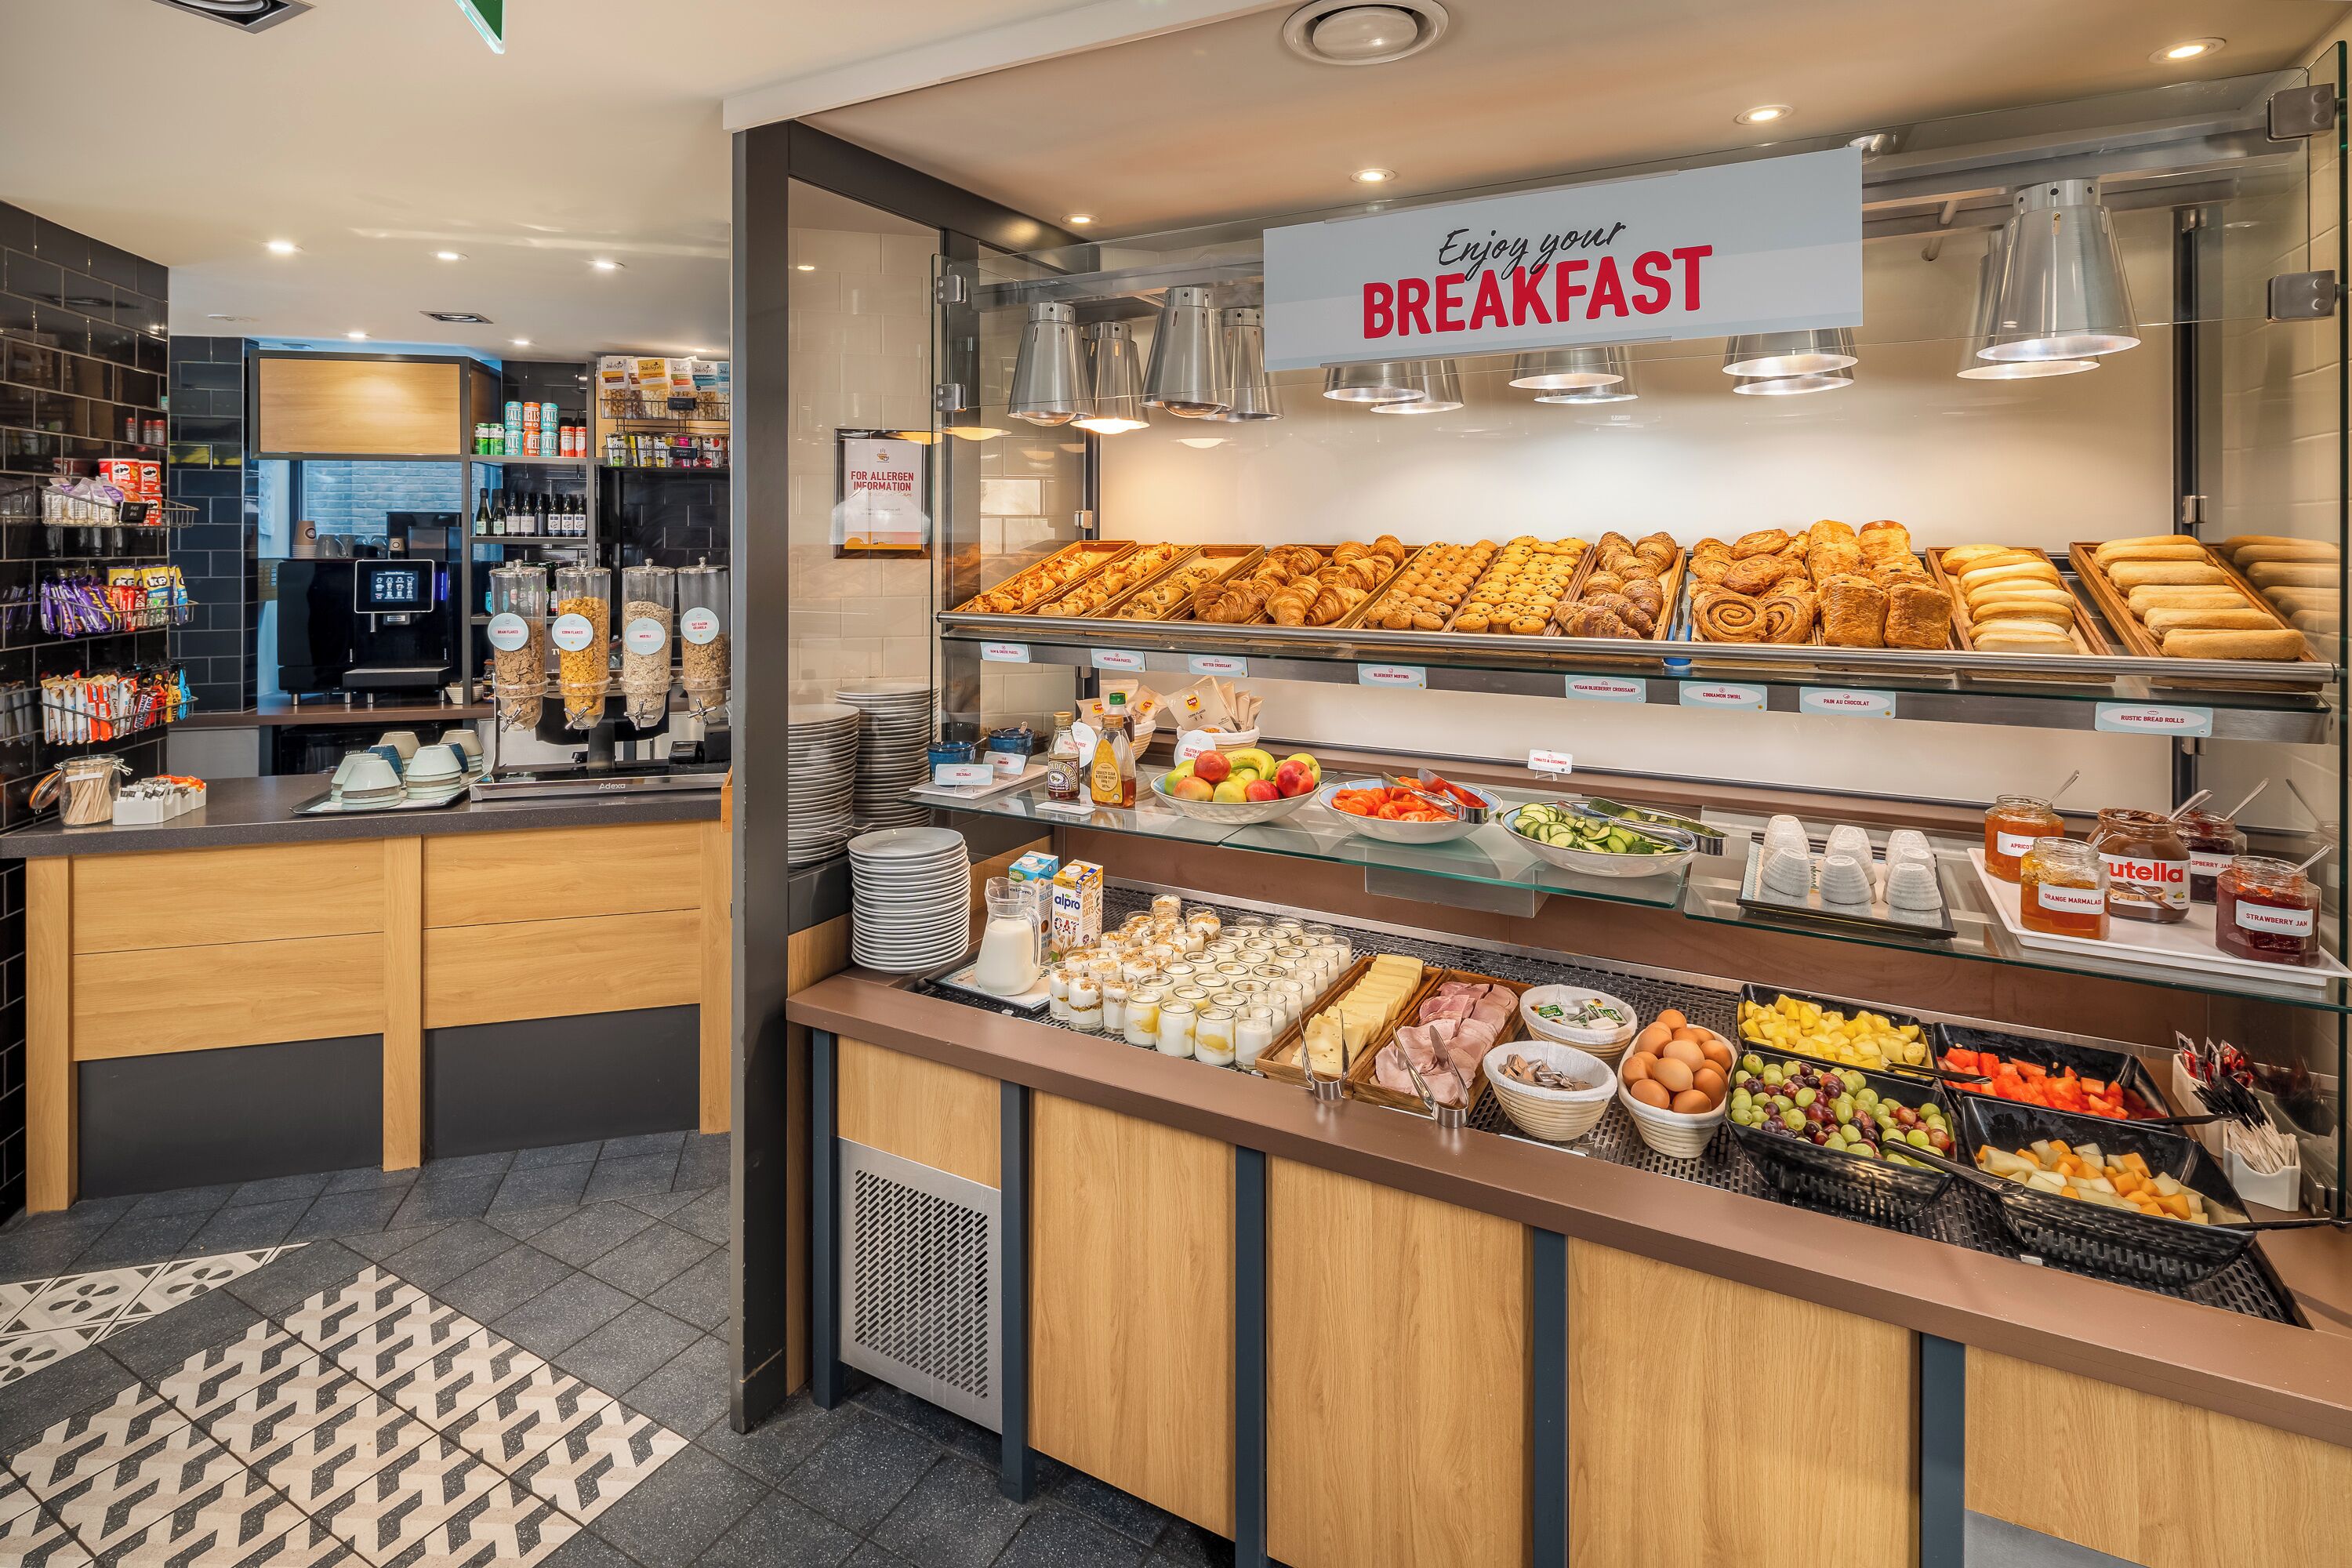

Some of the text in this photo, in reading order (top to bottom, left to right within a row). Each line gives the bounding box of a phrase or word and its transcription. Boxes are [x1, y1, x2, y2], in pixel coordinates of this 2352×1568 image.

[1438, 221, 1627, 281] Enjoy your
[1363, 245, 1713, 339] BREAKFAST
[506, 410, 521, 421] PALE
[524, 411, 540, 422] HELLS
[543, 412, 557, 422] PALE
[527, 439, 541, 450] HELL
[542, 439, 557, 450] PALE
[851, 471, 914, 481] FOR ALLERGEN
[853, 481, 911, 491] INFORMATION
[147, 577, 167, 586] KP
[1067, 768, 1077, 789] SYRUP
[2108, 862, 2183, 883] utella
[1054, 893, 1080, 910] alpro
[2044, 893, 2066, 903] ORANGE
[1055, 911, 1079, 921] HOMEGROWN
[1083, 906, 1094, 918] OATS
[2245, 913, 2293, 926] STRAWBERRY
[1054, 917, 1079, 935] OAT
